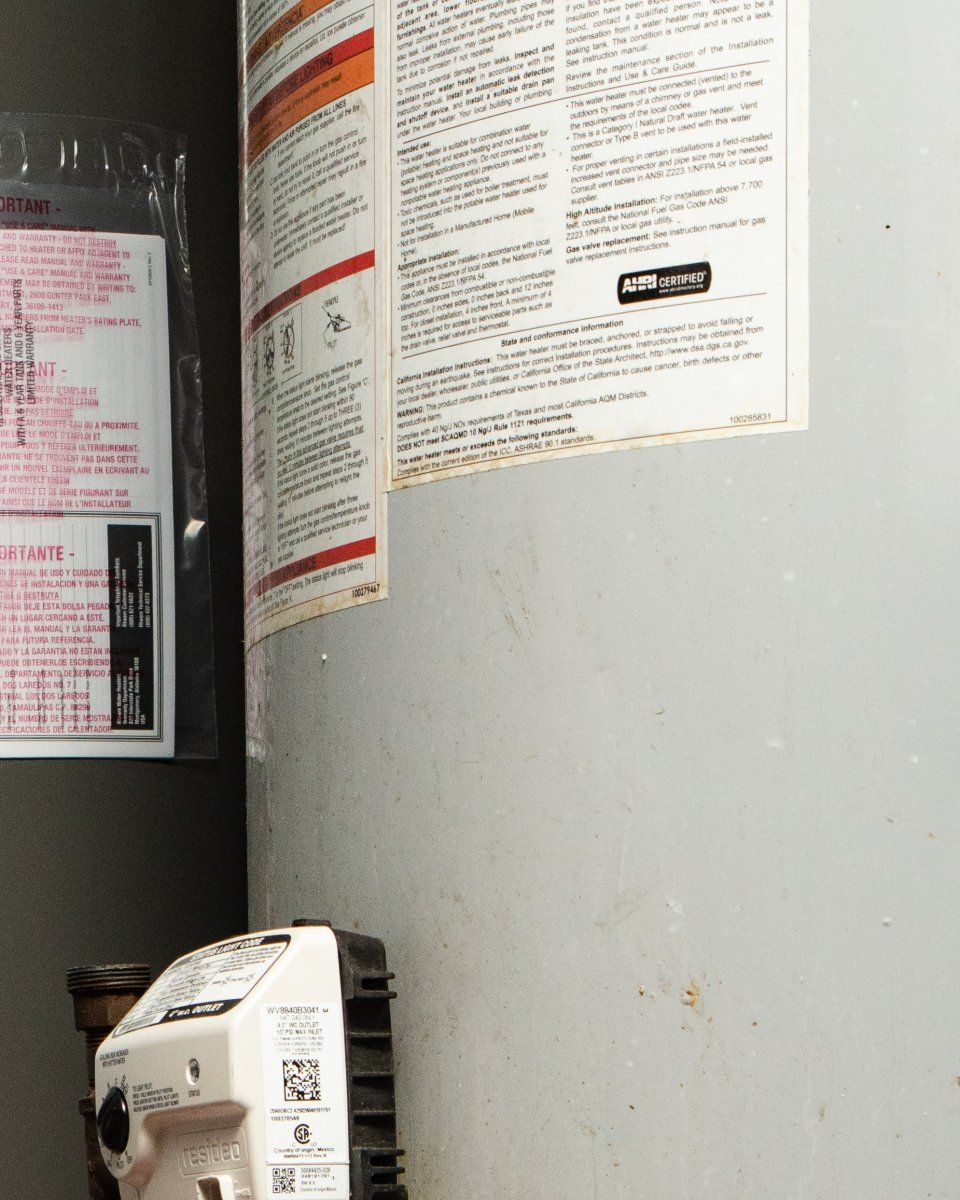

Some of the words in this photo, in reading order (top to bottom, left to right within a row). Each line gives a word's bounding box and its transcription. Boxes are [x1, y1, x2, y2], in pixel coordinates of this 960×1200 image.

[622, 274, 657, 293] AHRI
[501, 338, 517, 347] State
[520, 335, 531, 344] and
[534, 328, 578, 339] conformance
[581, 320, 623, 331] information
[397, 406, 424, 418] WARNING:
[426, 402, 437, 410] This
[438, 398, 458, 409] product
[460, 394, 482, 404] contains
[490, 388, 515, 398] chemical
[518, 384, 538, 392] known
[560, 377, 577, 385] State
[588, 370, 619, 381] California
[631, 365, 652, 374] cause
[655, 362, 680, 370] cancer,
[702, 356, 730, 364] defects
[742, 352, 762, 360] other
[730, 413, 771, 423] 100285831
[184, 1138, 241, 1168] resideo
